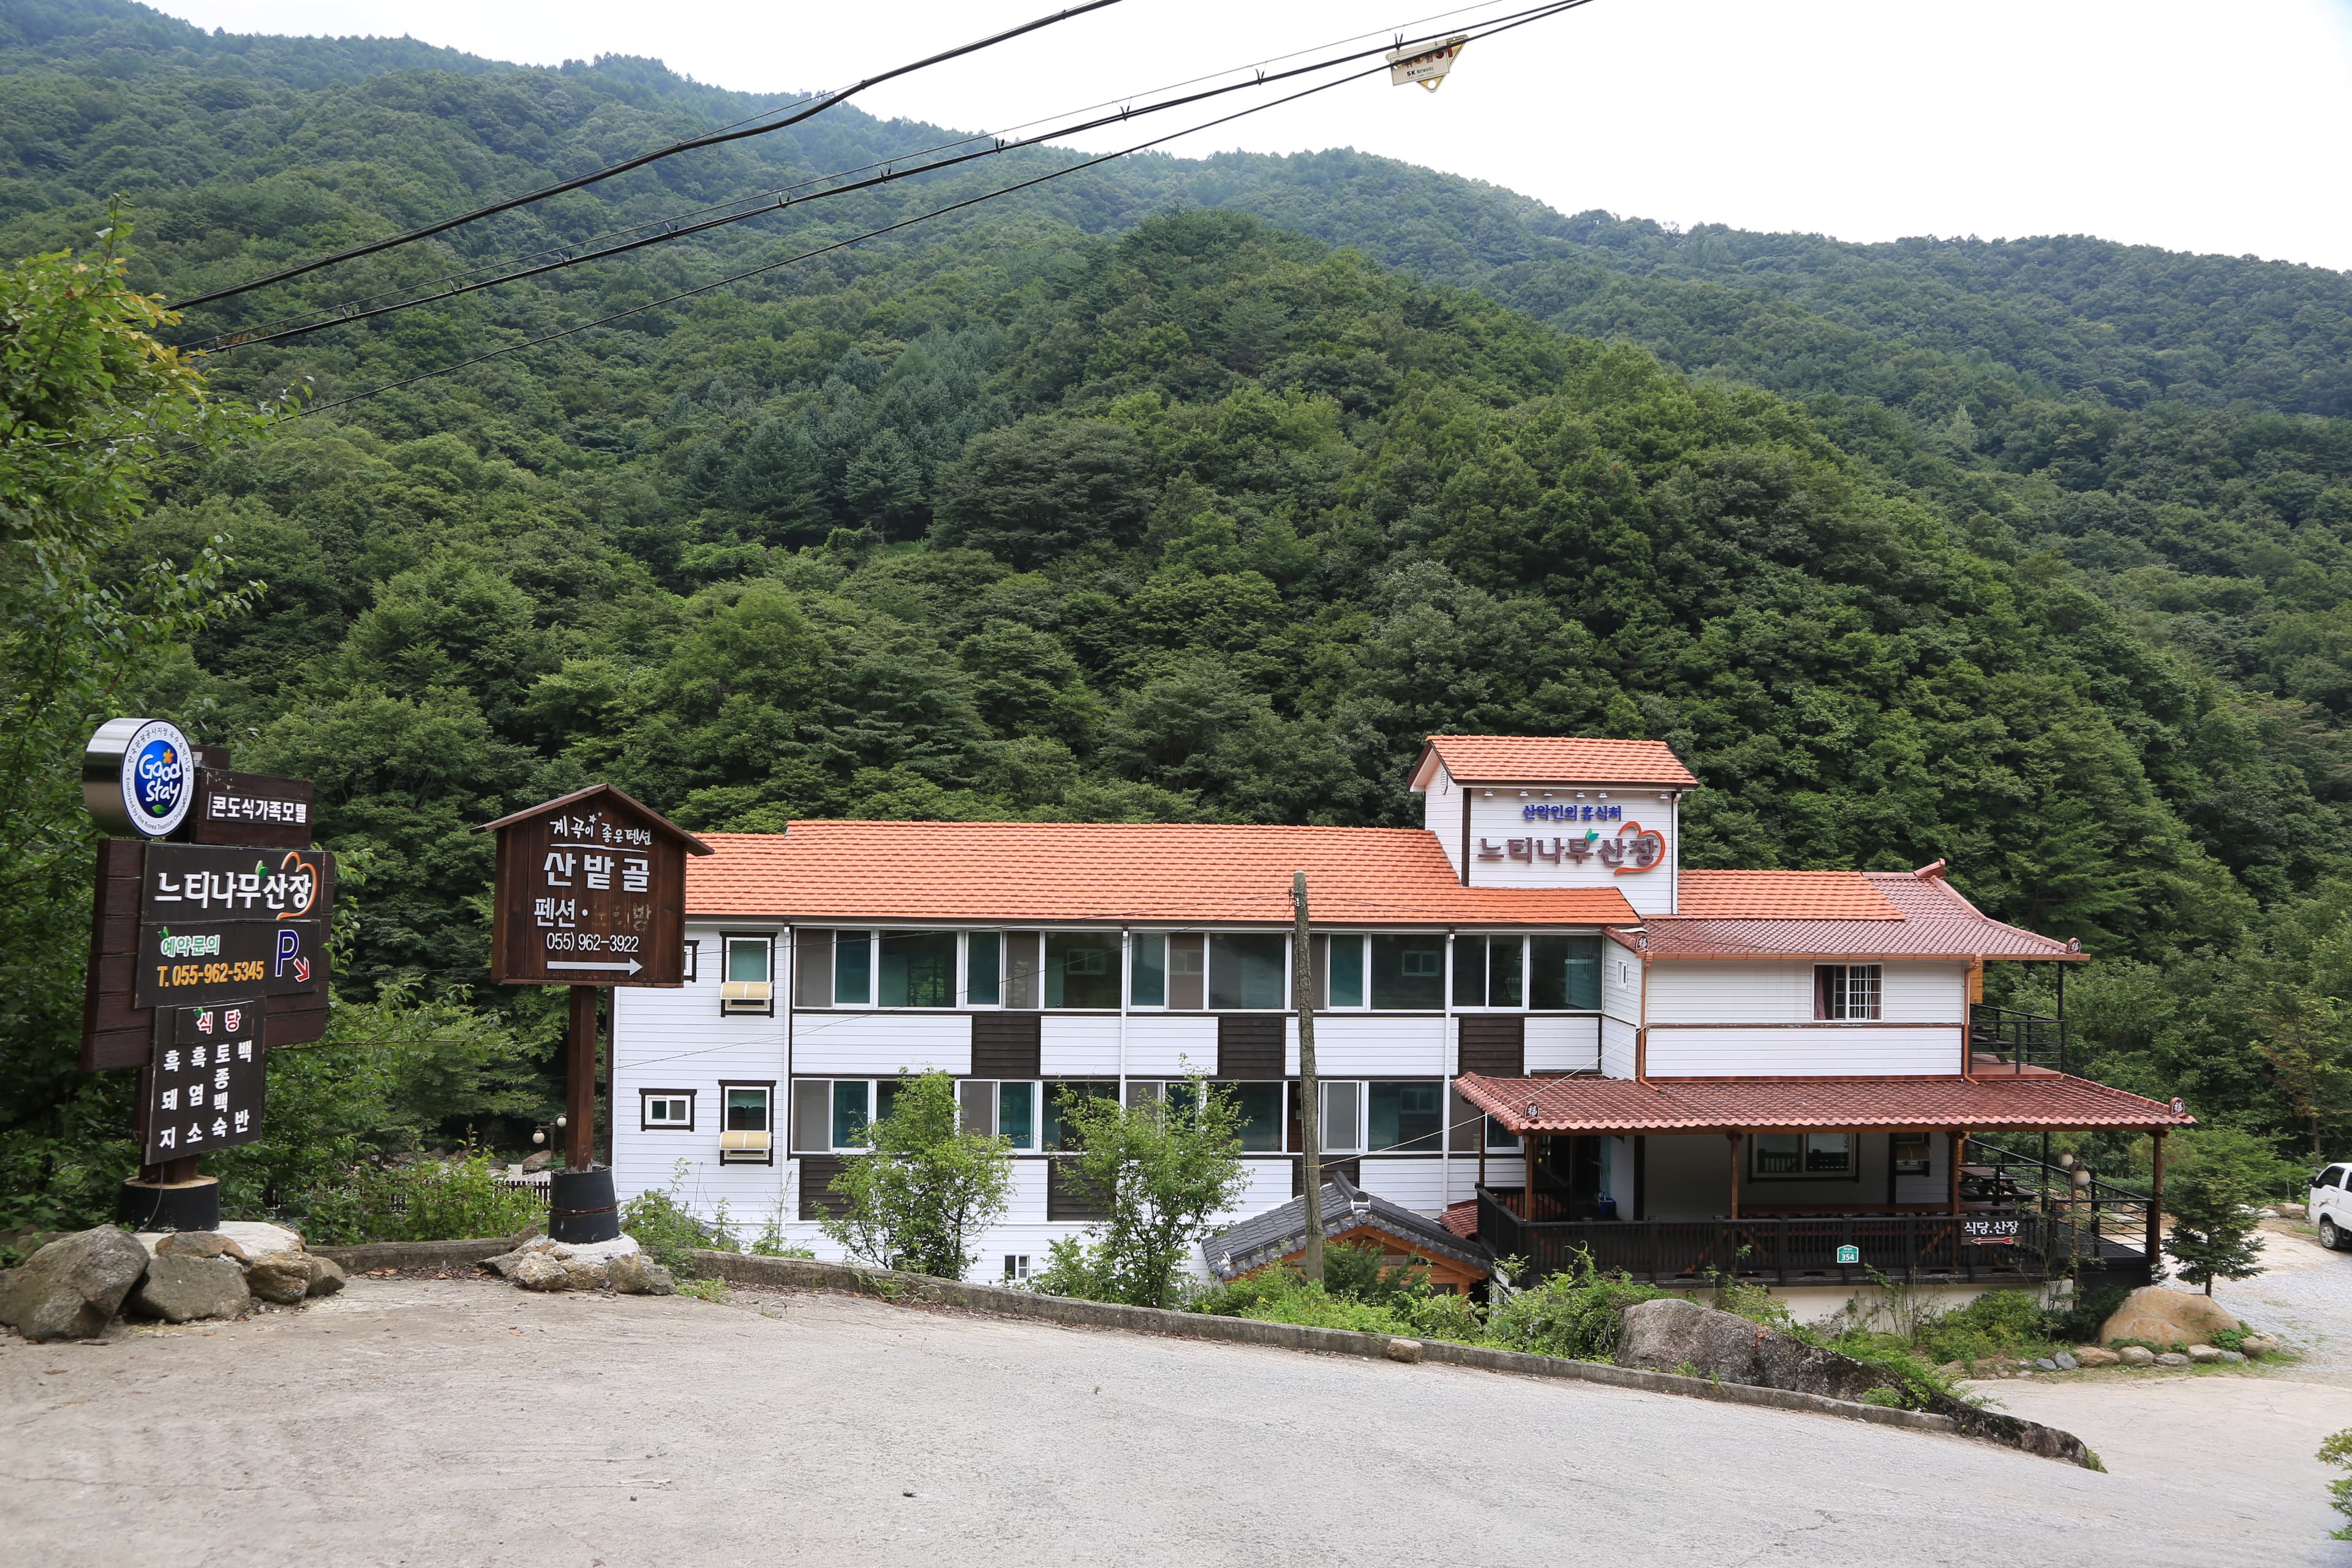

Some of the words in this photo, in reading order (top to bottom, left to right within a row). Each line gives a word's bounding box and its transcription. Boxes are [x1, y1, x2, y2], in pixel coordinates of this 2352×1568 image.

[138, 754, 181, 781] Good
[126, 777, 135, 809] Endorsed
[144, 821, 157, 830] Korea
[157, 820, 175, 830] Tourism
[211, 796, 307, 824] 콘도식가족모텔
[1523, 804, 1578, 821] 산악인의
[1581, 805, 1622, 821] 휴식처
[549, 815, 594, 840] 계곡이
[601, 823, 624, 843] 좋은
[1477, 837, 1659, 865] 느티나무산장
[154, 870, 312, 910] 느티나무산장
[160, 934, 221, 958] 예약문의
[275, 929, 300, 978] P
